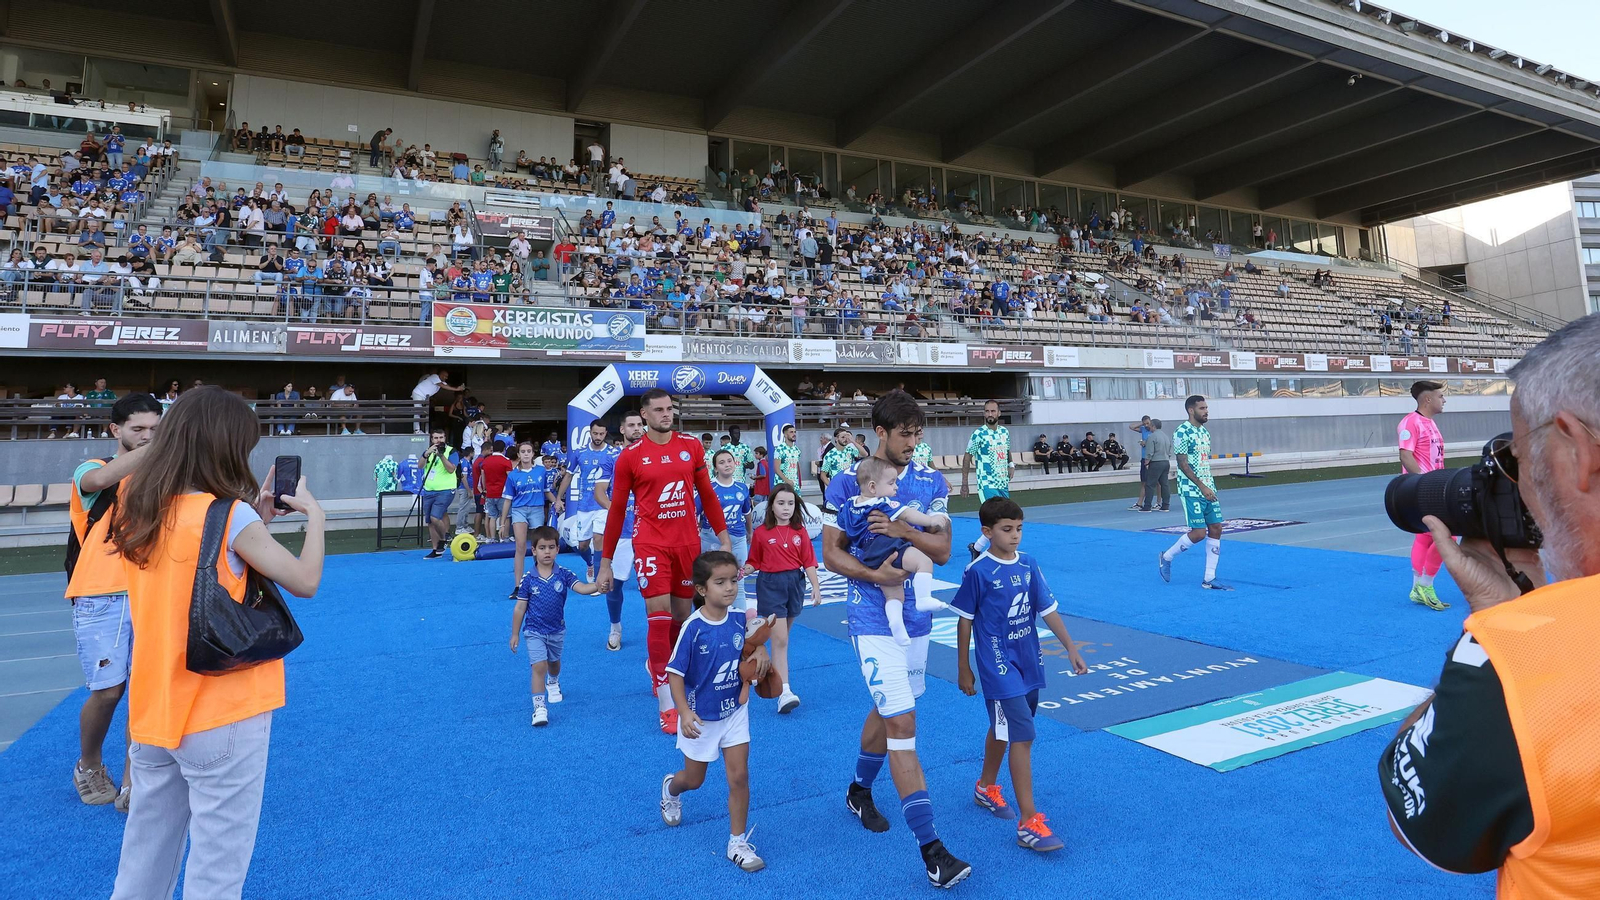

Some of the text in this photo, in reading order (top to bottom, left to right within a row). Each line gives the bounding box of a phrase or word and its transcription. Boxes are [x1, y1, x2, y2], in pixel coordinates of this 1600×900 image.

[492, 309, 593, 327] XERECISTAS
[40, 324, 108, 338] PLAY
[492, 325, 522, 338] POR
[525, 326, 543, 338] EL
[543, 327, 594, 340] MUNDO
[296, 331, 351, 345] PLAY
[682, 343, 733, 356] LIMENTOS
[734, 344, 750, 356] DE
[972, 350, 1001, 359] PLAY
[1177, 355, 1198, 363] PLAY
[1258, 357, 1277, 365] PLAY
[628, 370, 659, 381] XEREZ
[717, 372, 747, 384] Diver
[630, 380, 657, 388] DEPORTIVO
[671, 490, 686, 501] Air
[659, 500, 685, 509] oneair.es
[1193, 501, 1202, 514] 3
[657, 509, 686, 520] datono
[635, 556, 658, 577] 25
[1019, 603, 1031, 616] Air
[864, 656, 883, 687] 2
[1107, 668, 1149, 680] DE
[1037, 656, 1259, 709] AYUNTAMIENTO
[1230, 698, 1369, 738] JEREZ 2031
